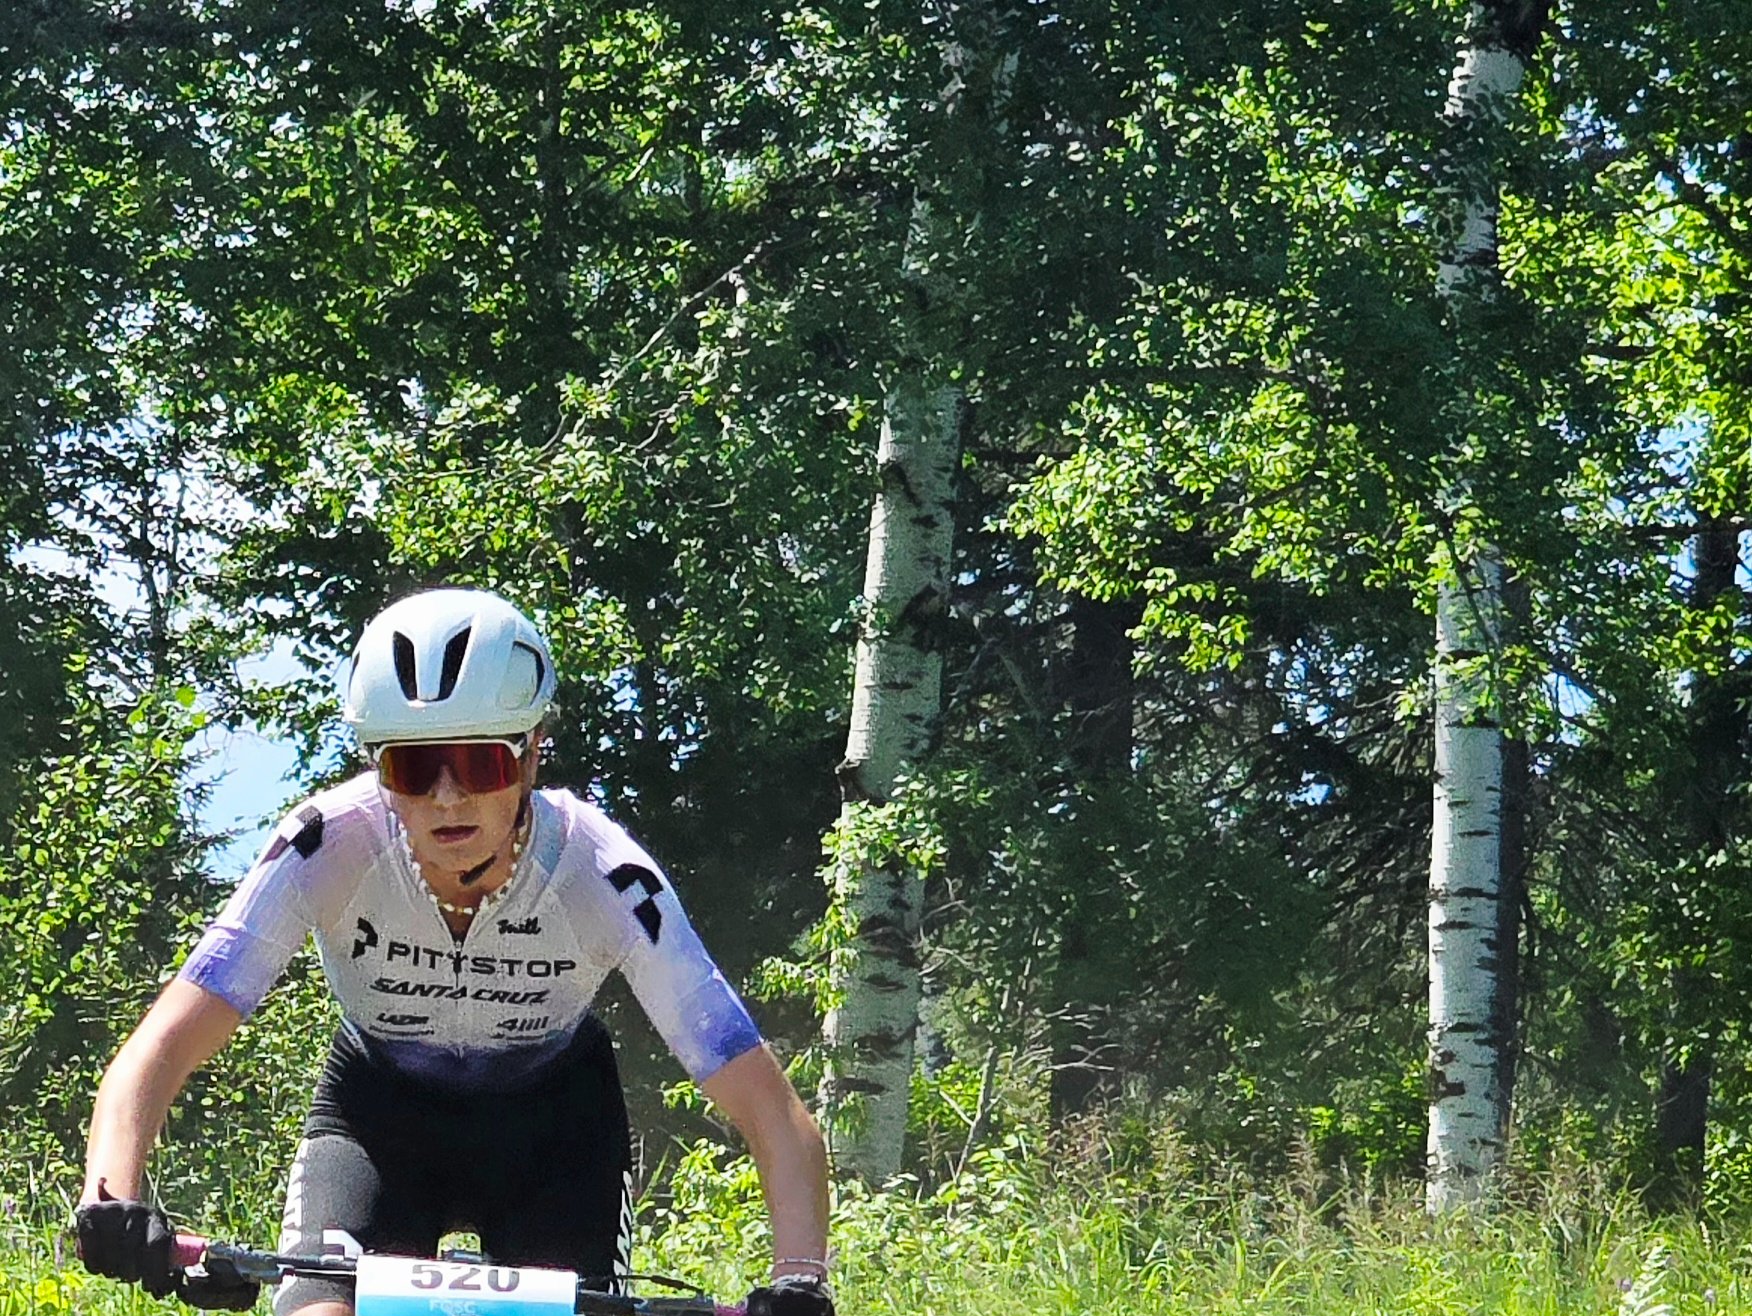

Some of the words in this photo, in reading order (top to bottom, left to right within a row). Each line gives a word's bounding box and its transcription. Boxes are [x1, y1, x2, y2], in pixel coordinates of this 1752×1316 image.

[369, 976, 468, 999] SANTA
[470, 988, 551, 1005] CRUZ
[410, 1263, 520, 1293] 520
